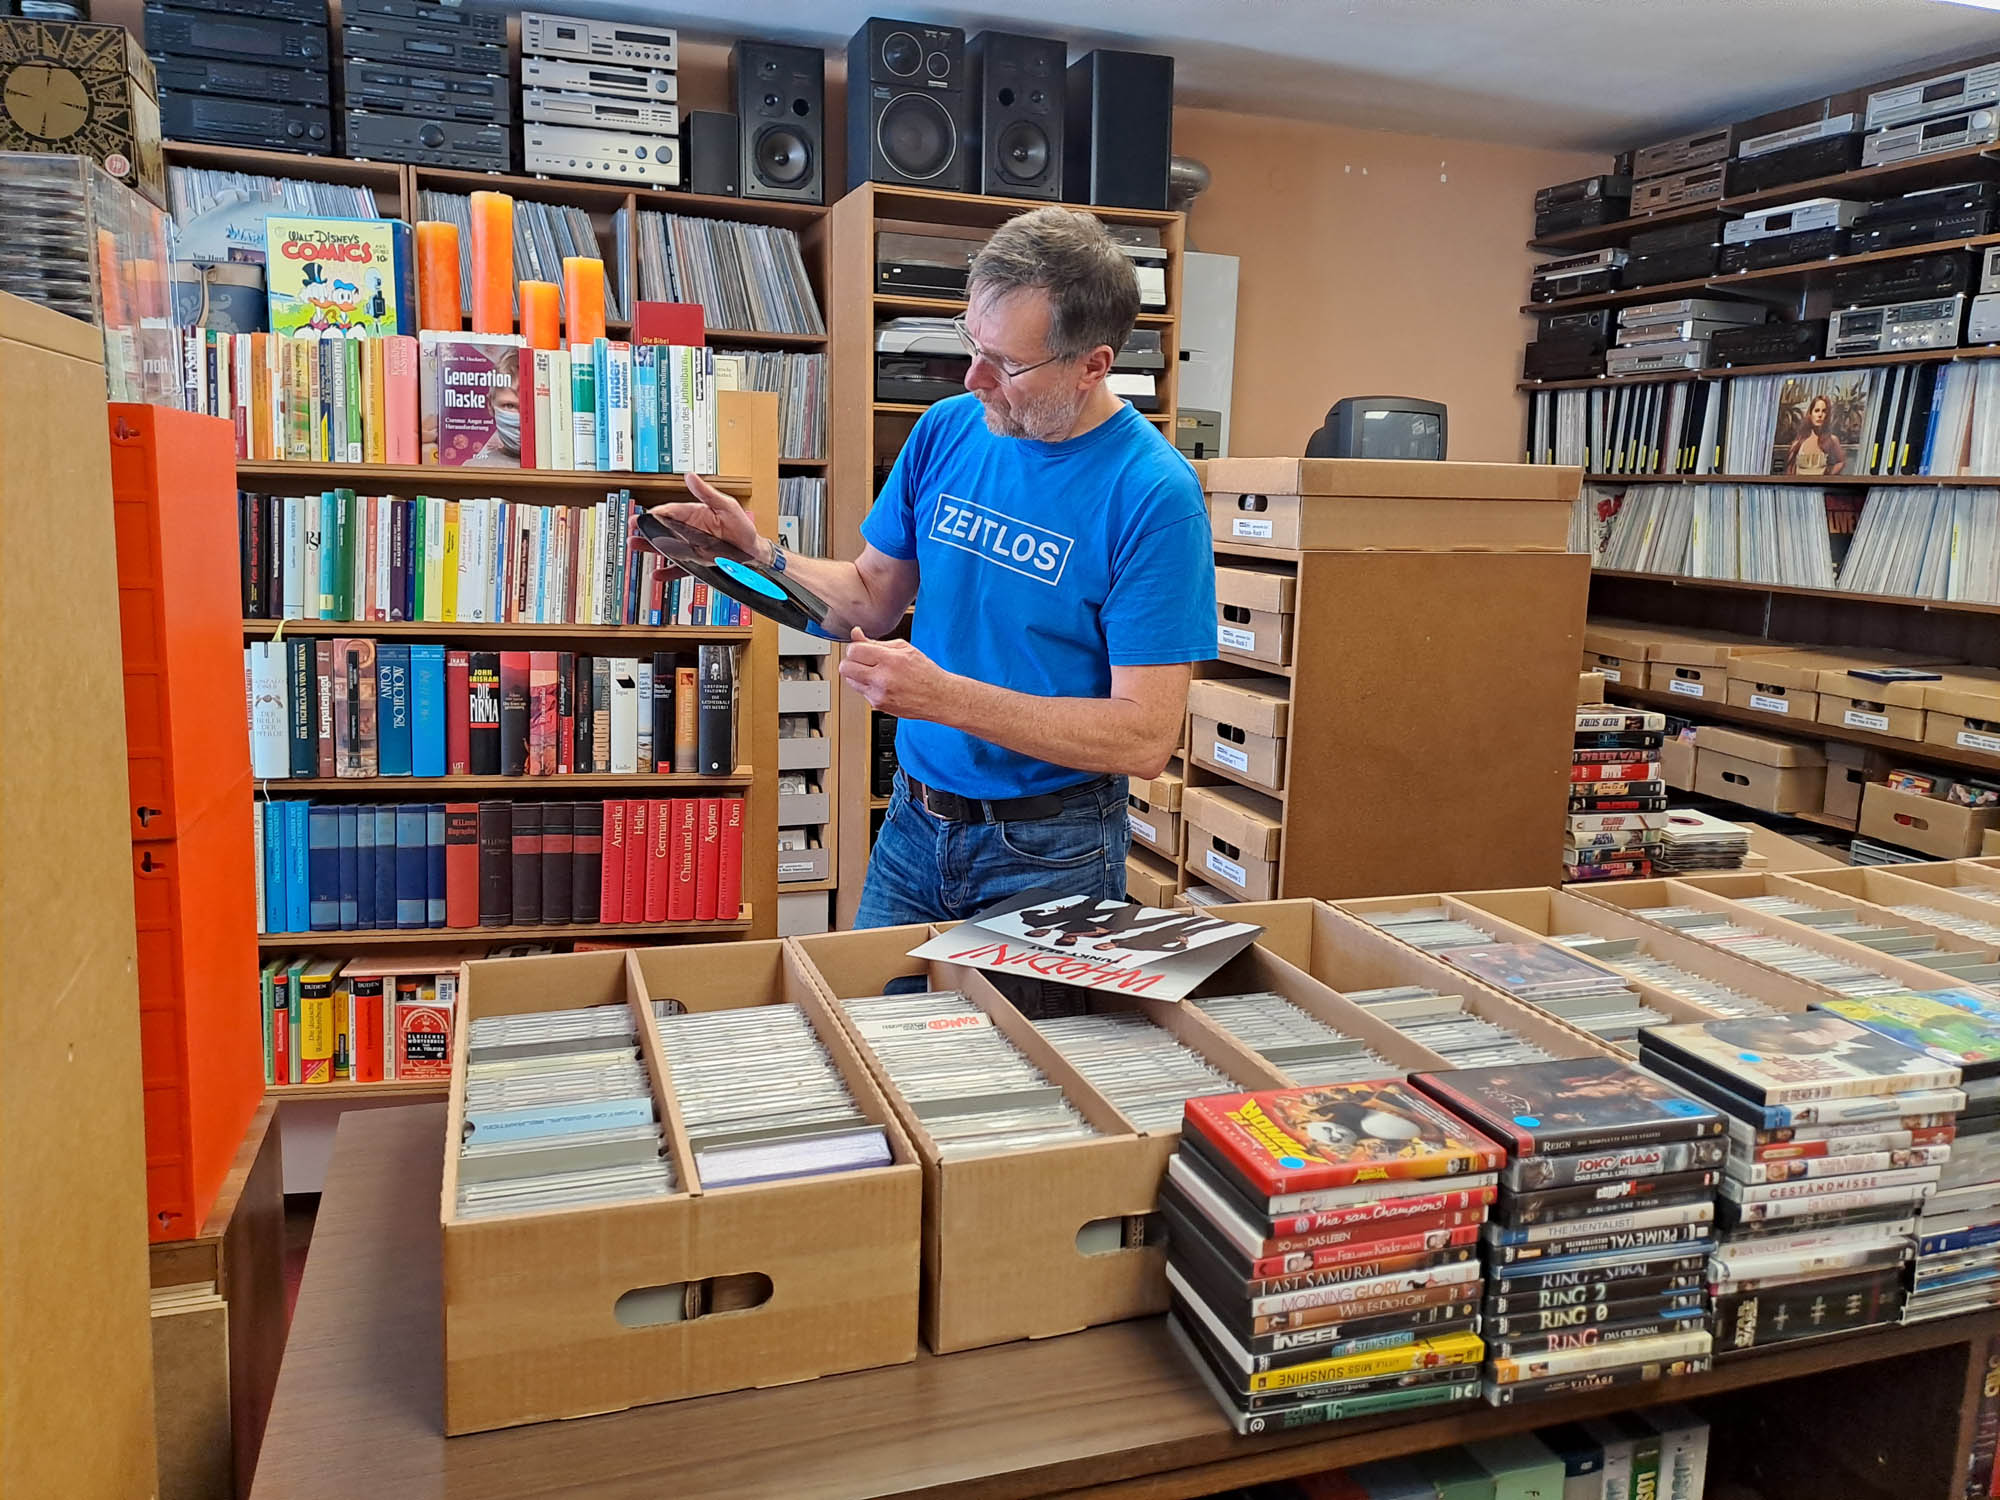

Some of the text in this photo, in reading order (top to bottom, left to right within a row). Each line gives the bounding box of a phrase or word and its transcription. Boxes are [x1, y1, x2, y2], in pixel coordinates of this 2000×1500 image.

[288, 230, 314, 242] WALT
[281, 241, 372, 264] COMICS
[653, 337, 670, 345] Bibel
[185, 369, 197, 388] Der
[444, 367, 512, 388] Generation
[609, 359, 621, 409] Kinder-
[444, 389, 486, 408] Maske
[679, 354, 692, 454] Heilung des Unheilbaren
[661, 413, 669, 424] Die
[936, 504, 1060, 571] ZEITLOS
[299, 671, 308, 686] VON
[380, 666, 391, 699] ANTON
[477, 684, 490, 699] DIE
[299, 687, 308, 724] TIGERCLAN
[318, 675, 332, 739] Karpatenjagd
[469, 694, 499, 722] FIRMA
[299, 726, 308, 739] DER
[1579, 718, 1620, 727] RED SURF
[1620, 751, 1641, 761] WAR
[634, 805, 645, 835] Hellas
[729, 803, 740, 827] Rom
[611, 805, 623, 848] Amerika
[655, 803, 668, 858] Germanien
[680, 803, 694, 882] China und Japan
[1030, 945, 1061, 954] BEAT
[948, 943, 1167, 994] WHODINI
[1240, 1098, 1333, 1166] PANDA
[1543, 1140, 1571, 1152] REIGN
[1576, 1152, 1661, 1172] JOKO KLAAS
[1769, 1177, 1877, 1199] GESTÄNDNISSE
[1316, 1196, 1447, 1228] Mia san Champions!
[1550, 1218, 1631, 1236] THE MENTALIST
[1278, 1232, 1352, 1251] SO DAS LEBEN
[1610, 1230, 1678, 1249] PRIMEVAL
[1261, 1264, 1381, 1296] LAST SAMURAI
[1281, 1280, 1402, 1312] MORNING GLORY
[1539, 1284, 1607, 1308] RING 2
[1539, 1304, 1608, 1329] RING 0
[1547, 1325, 1659, 1351] RING DAS ORIGINAL
[1278, 1366, 1345, 1386] SUNSHINE
[1347, 1363, 1373, 1374] MISS
[1326, 1401, 1343, 1421] 16
